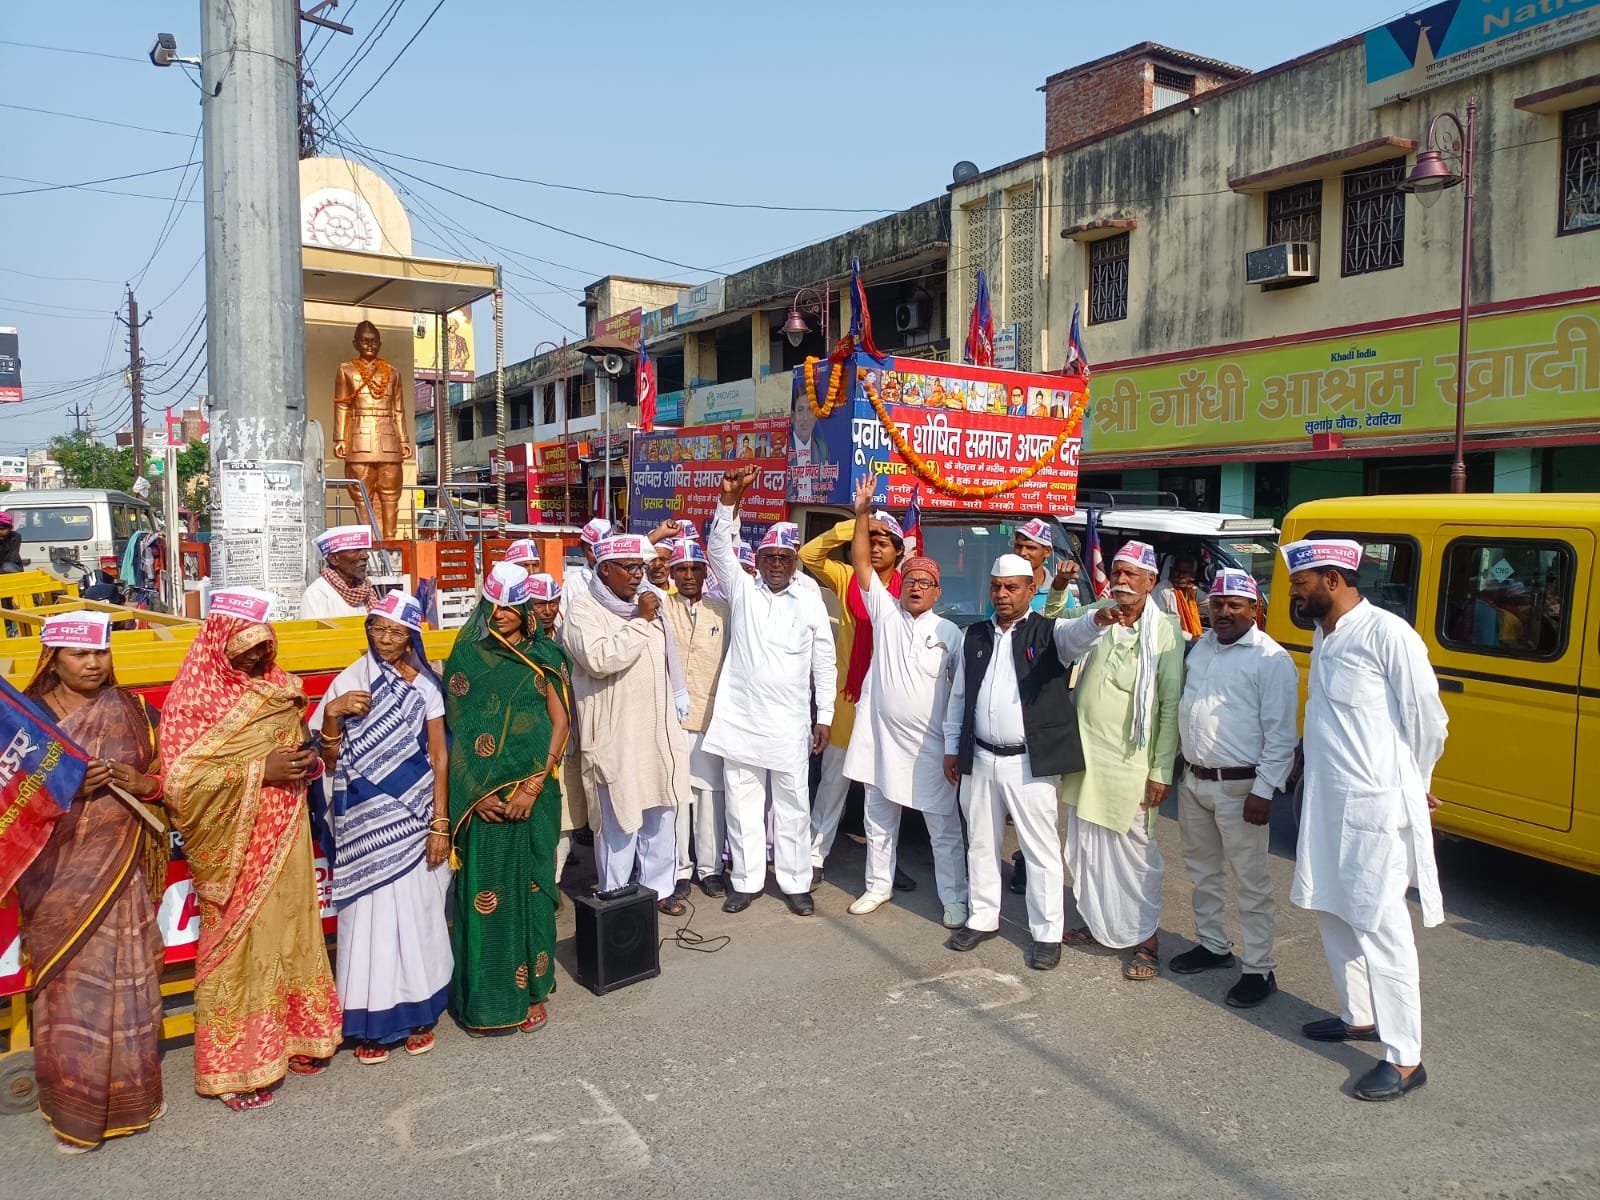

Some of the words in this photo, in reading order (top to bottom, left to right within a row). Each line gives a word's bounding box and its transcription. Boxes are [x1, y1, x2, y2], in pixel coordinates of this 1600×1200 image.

[1482, 0, 1585, 36] Nati
[1331, 349, 1354, 363] Khadi
[1356, 347, 1377, 361] India
[1093, 377, 1141, 434] श्री
[1149, 363, 1251, 428] गाँधी
[1257, 357, 1423, 421] आश्रम
[1435, 313, 1600, 408] खादी
[1335, 411, 1363, 432] चौक,
[1365, 412, 1402, 429] देवरिया
[913, 413, 962, 457] शोषित
[965, 429, 1013, 460] समाज
[664, 463, 692, 489] शोषित
[869, 456, 908, 477] (प्रसाद
[763, 470, 788, 492] दल
[641, 494, 664, 512] (प्रसाद
[665, 494, 686, 512] पार्टी)
[1296, 548, 1332, 559] प्रसाद
[1494, 567, 1510, 576] CNG
[60, 625, 89, 636] पार्टी
